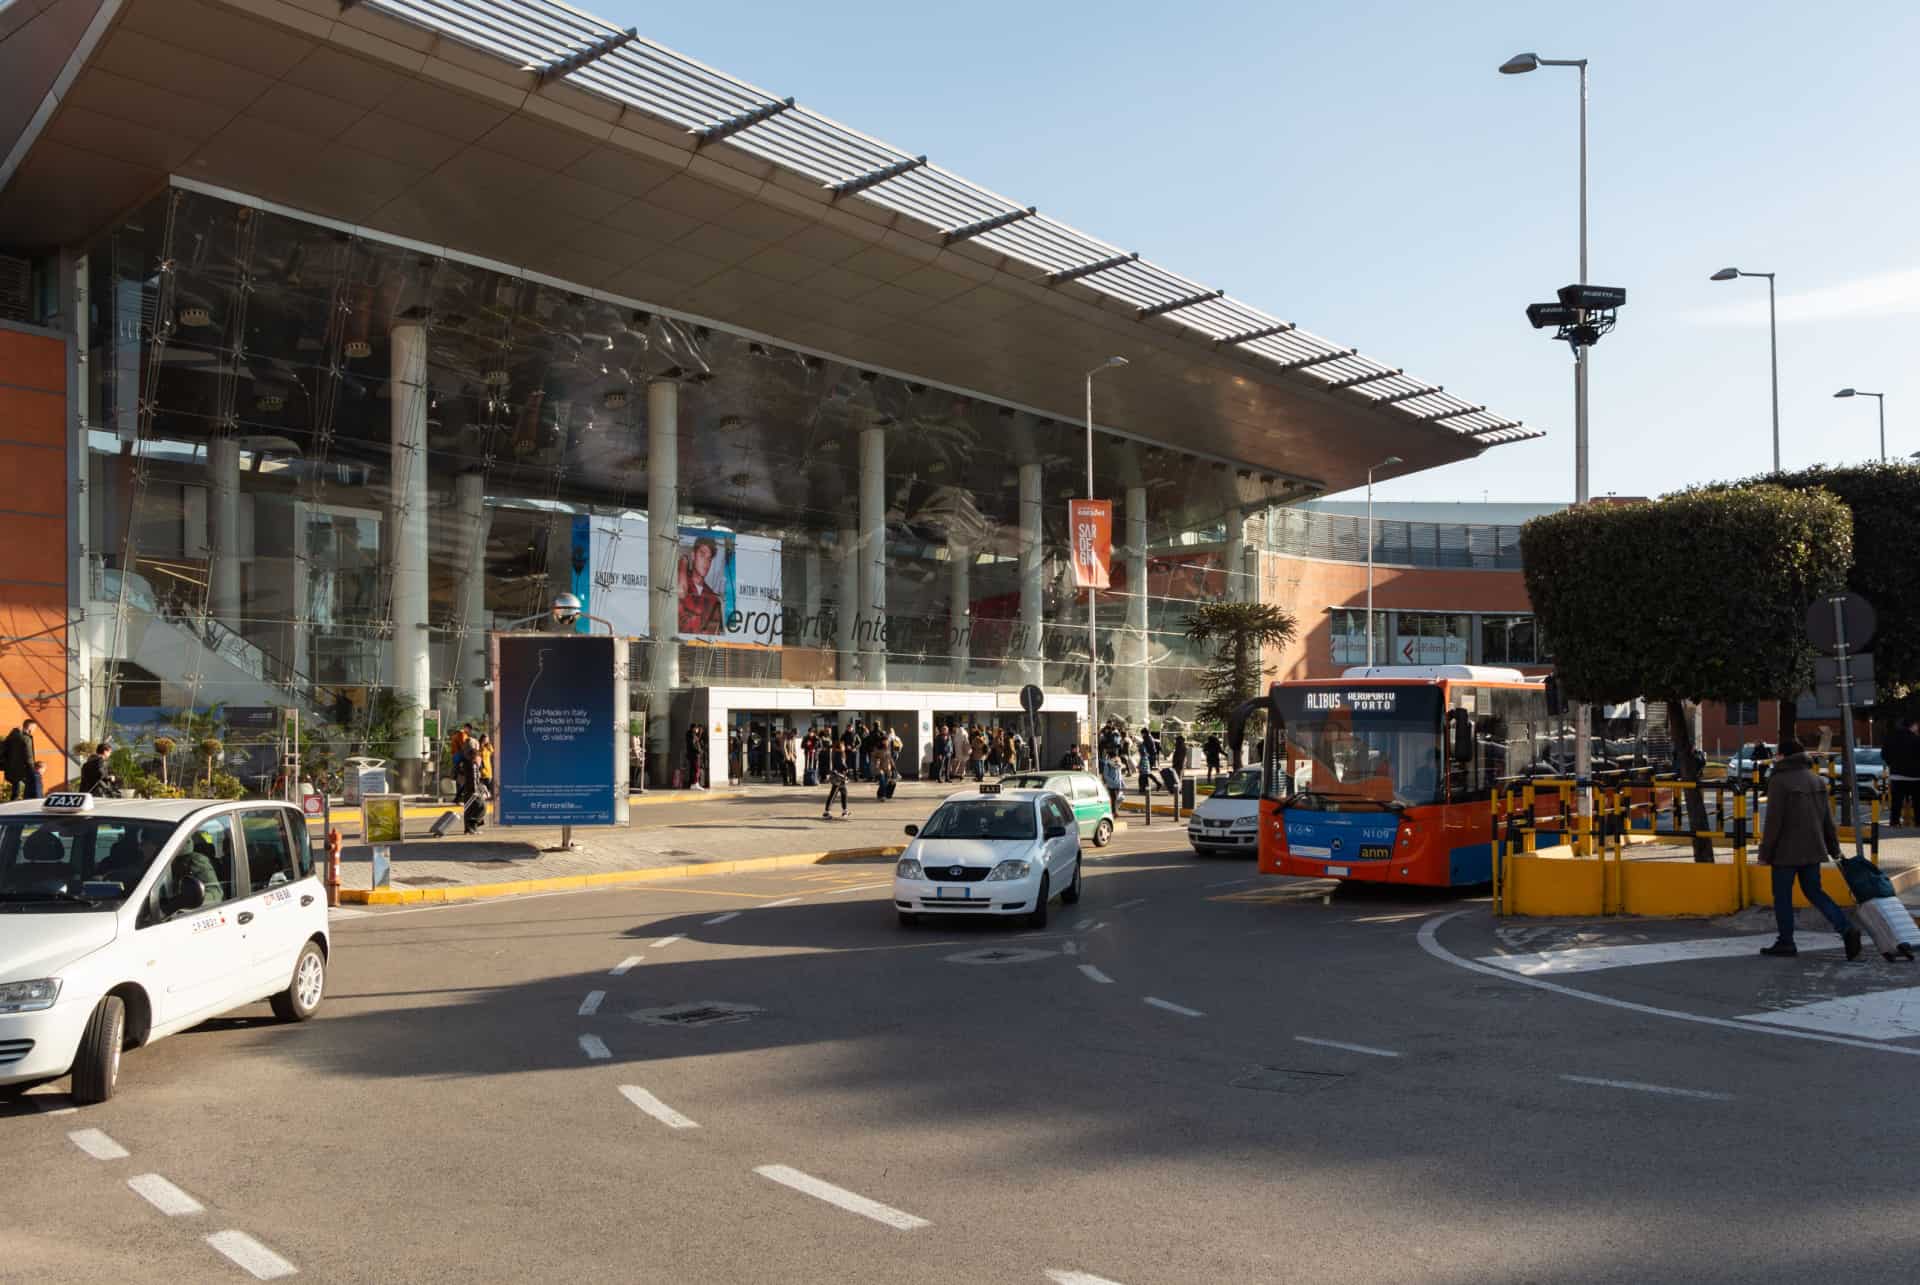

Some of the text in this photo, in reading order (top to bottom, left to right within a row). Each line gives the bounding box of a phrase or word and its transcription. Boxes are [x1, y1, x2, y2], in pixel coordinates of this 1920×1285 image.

[1307, 693, 1340, 709] ALIBUS
[1354, 701, 1391, 710] PORTO
[48, 795, 82, 806] TAXI
[1362, 848, 1388, 858] anm
